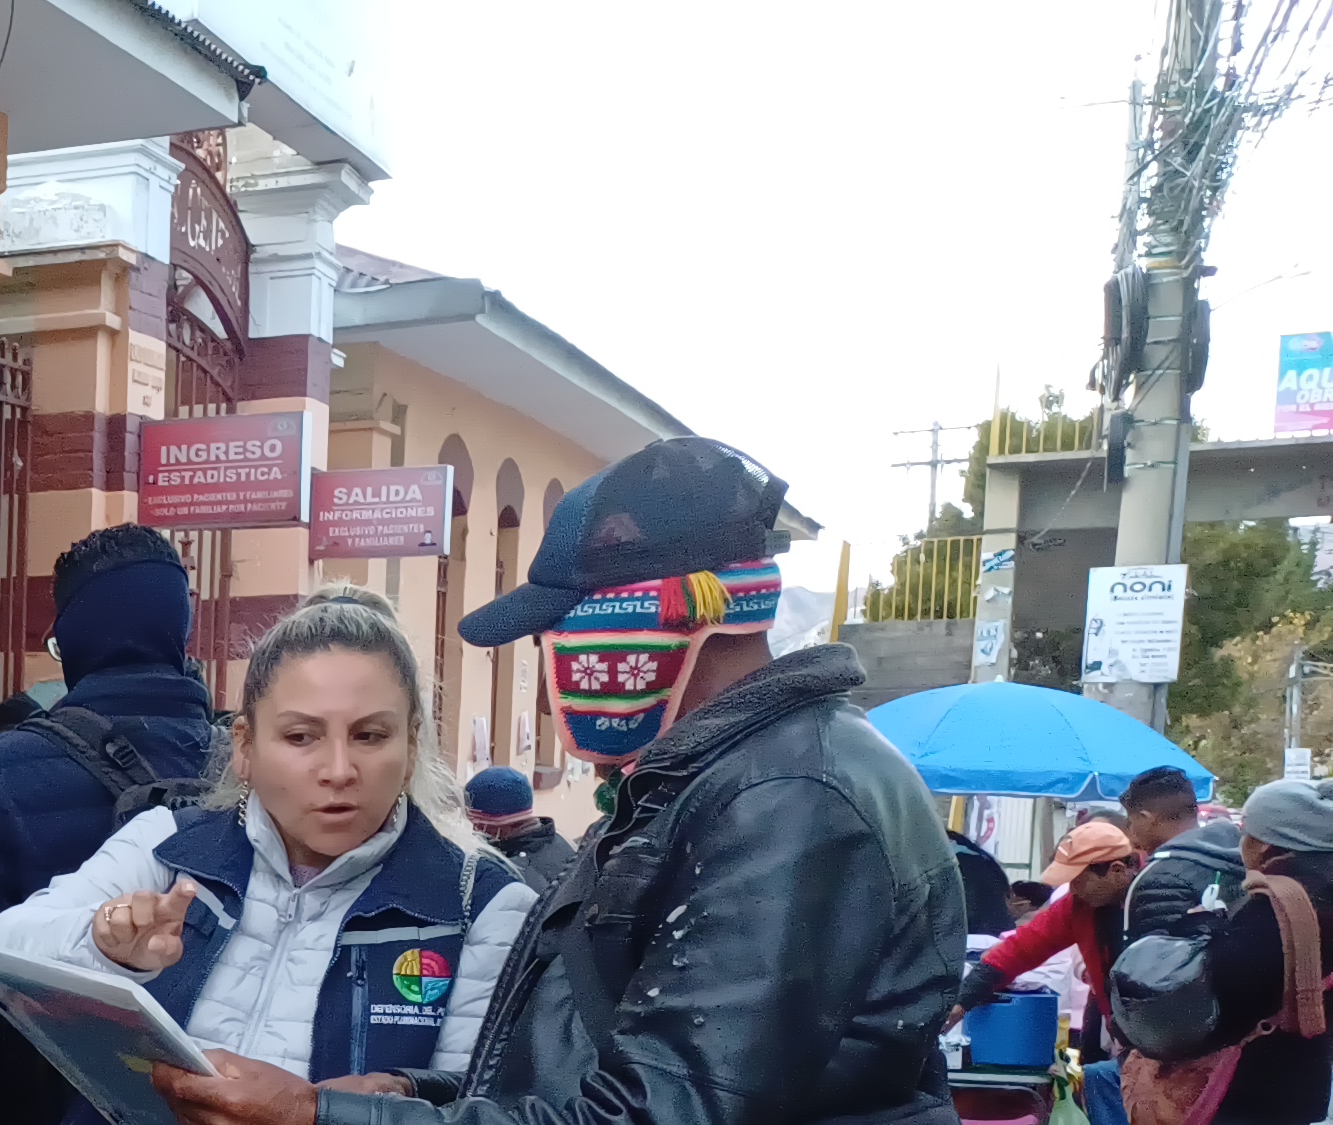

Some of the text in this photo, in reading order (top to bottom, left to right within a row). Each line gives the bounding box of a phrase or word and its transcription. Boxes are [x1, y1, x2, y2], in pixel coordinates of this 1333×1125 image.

[160, 438, 283, 465] INGRESO
[157, 465, 282, 486] ESTADÍSTICA
[193, 491, 237, 502] PACIENTES
[333, 484, 422, 504] SALIDA
[319, 506, 434, 521] INFORMACIONES
[329, 523, 424, 536] EXCLUSIVO PACIENTES
[1110, 580, 1173, 594] noni
